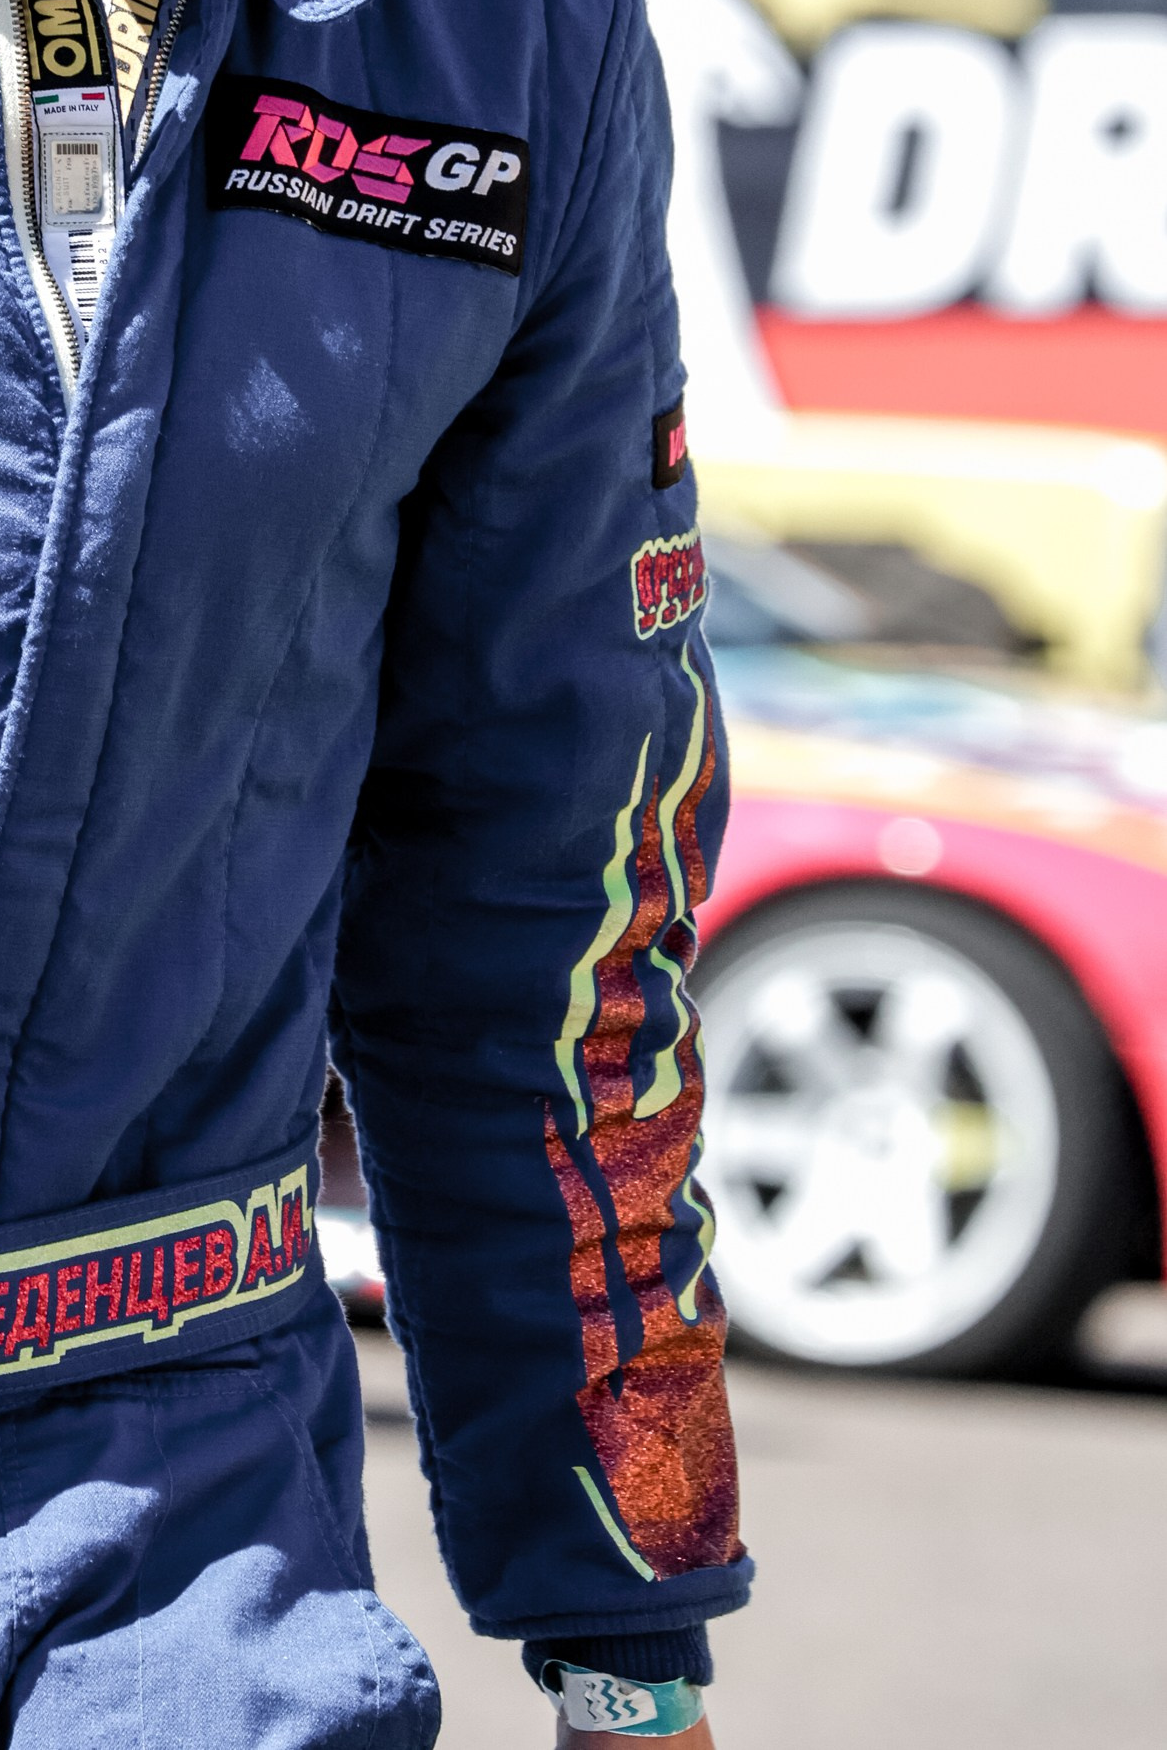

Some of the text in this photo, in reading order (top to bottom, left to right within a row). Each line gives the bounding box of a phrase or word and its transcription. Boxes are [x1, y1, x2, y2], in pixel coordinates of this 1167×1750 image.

[43, 105, 67, 115] MADE
[78, 104, 100, 112] ITALY
[239, 94, 522, 204] RDS GP
[224, 168, 518, 257] RUSSIAN DRIFT SERIES
